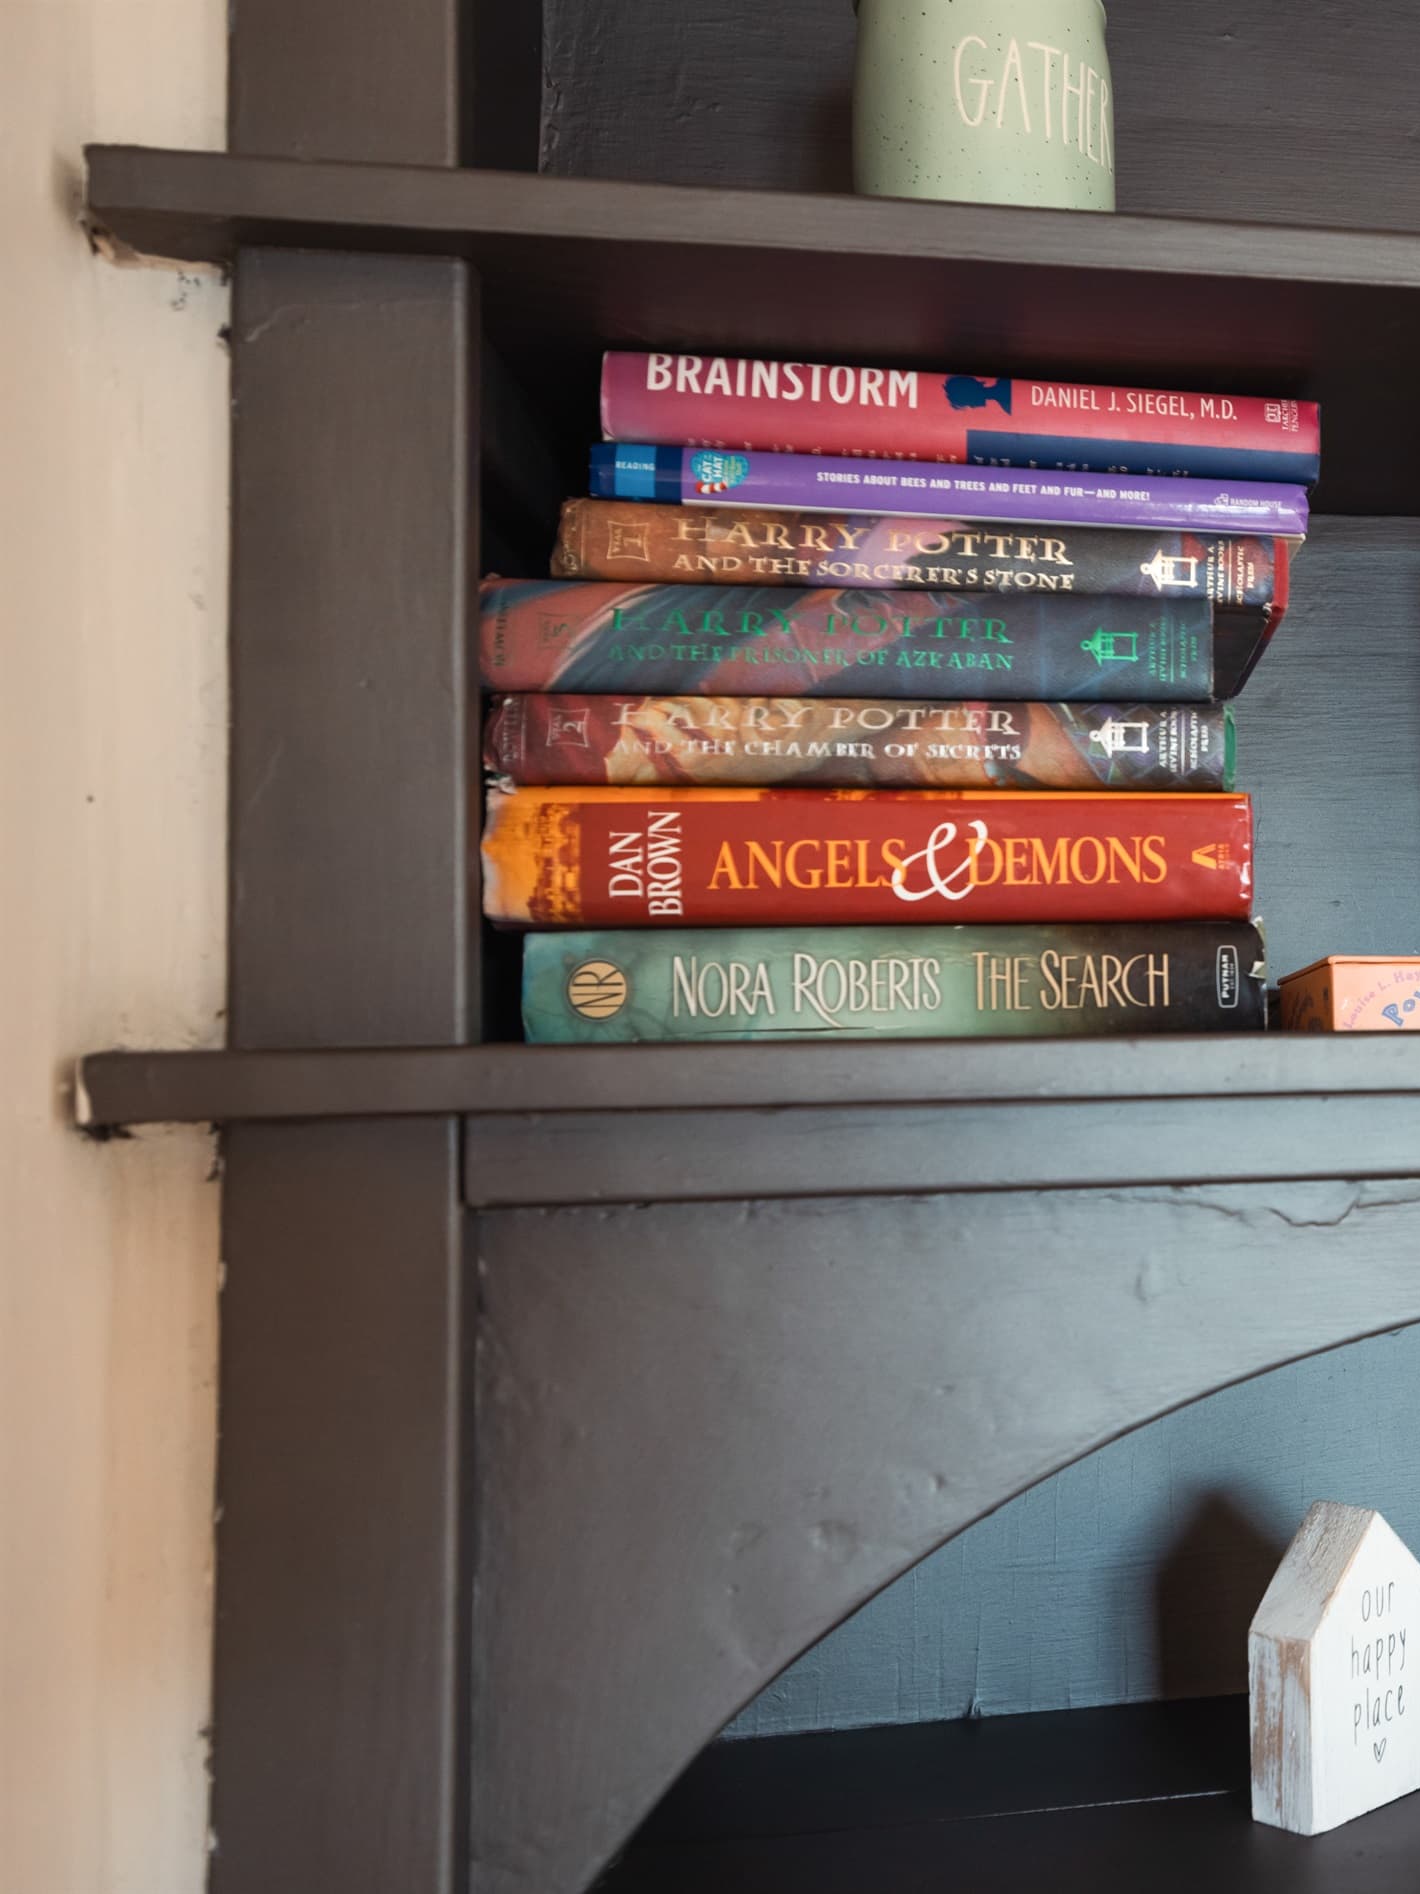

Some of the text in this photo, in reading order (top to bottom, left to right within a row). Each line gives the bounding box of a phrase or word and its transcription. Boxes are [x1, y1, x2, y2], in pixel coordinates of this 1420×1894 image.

[953, 35, 1113, 175] GATHER
[646, 353, 919, 409] BRAINSTORM
[1031, 385, 1238, 421] DANIEL J. SIEGEL, M.D.
[615, 460, 656, 471] READING
[816, 471, 860, 485] STORIES
[863, 473, 897, 486] ABOUT
[901, 475, 926, 488] BEES
[929, 477, 951, 489] AND
[954, 479, 986, 492] TREES
[988, 481, 1010, 493] AND
[1012, 482, 1037, 495] FEET
[1040, 484, 1061, 496] AND
[1119, 488, 1150, 501] MORE!
[670, 516, 1074, 565] HARRY POTTER
[672, 552, 1075, 591] AND THE SORCERER'S STONE
[611, 606, 800, 637] HARRY
[826, 612, 1015, 644] POTTER
[608, 643, 1015, 672] AND THE PRISONER OF AZKABAN
[610, 702, 1022, 735] HARRY POTTER
[612, 738, 1022, 761] AND THE CHAMBER OF SECRETS
[609, 831, 644, 898] DAN
[648, 810, 684, 916] BROWN
[706, 837, 907, 889] ANGELS
[891, 819, 988, 901] &
[967, 835, 1168, 887] DEMONS
[673, 953, 942, 1027] NORA ROBERTS
[972, 951, 1032, 1010] THE
[1040, 949, 1170, 1010] SEARCH
[1360, 1581, 1396, 1623] our
[1351, 1627, 1408, 1681] happy
[1353, 1684, 1406, 1745] place
